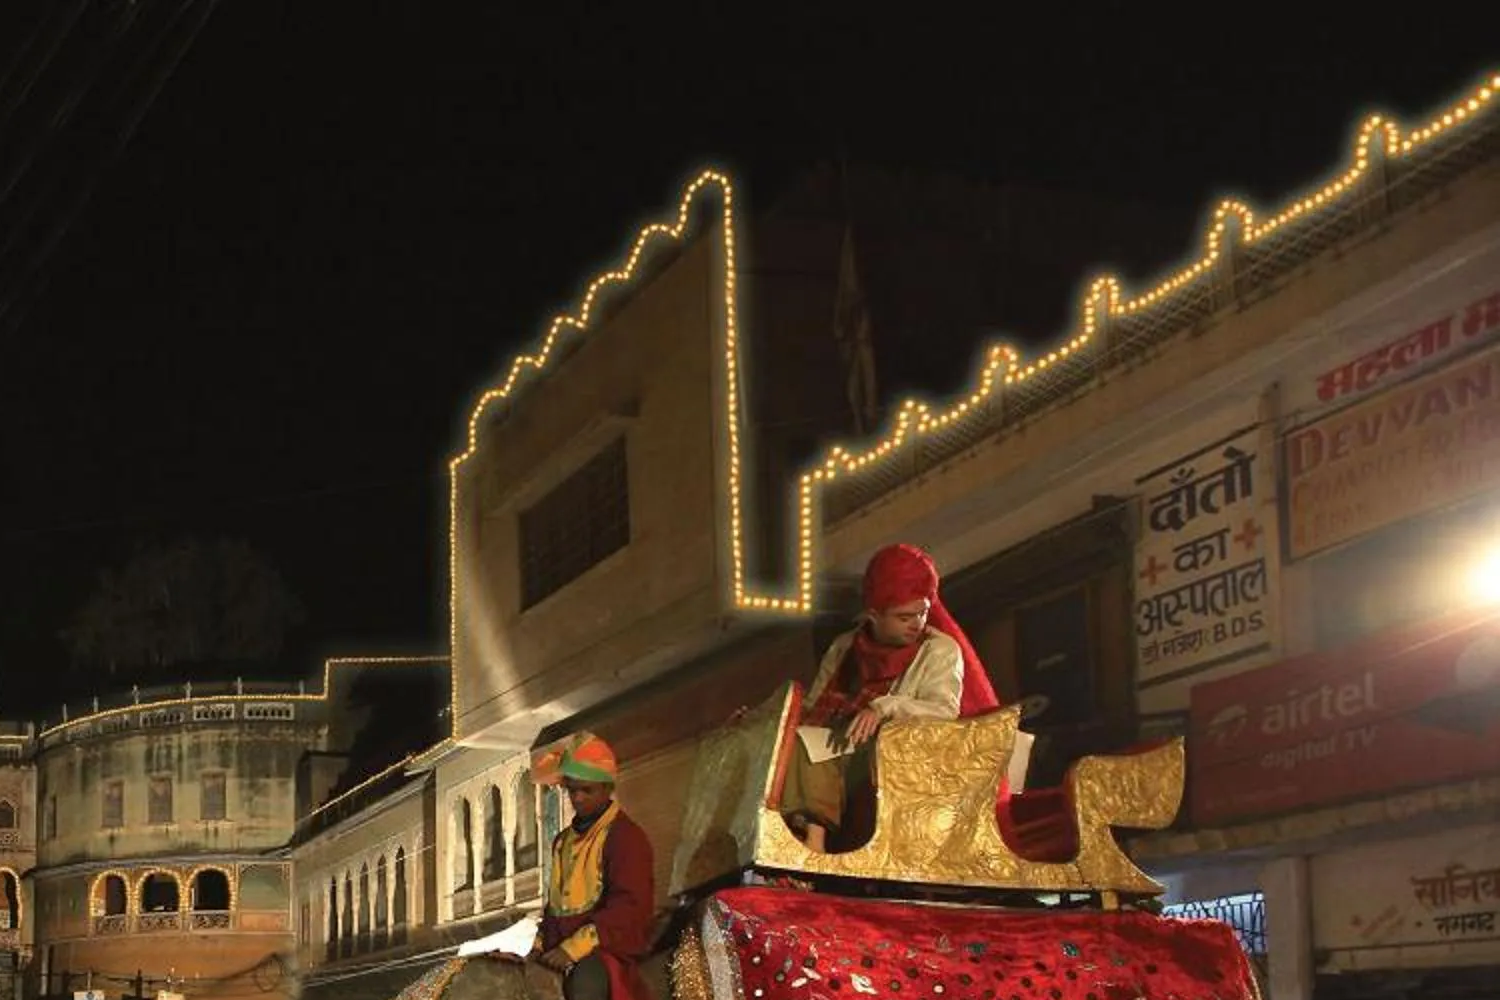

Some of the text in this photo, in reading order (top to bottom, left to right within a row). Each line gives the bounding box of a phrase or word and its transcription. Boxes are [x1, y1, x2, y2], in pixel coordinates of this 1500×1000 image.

[1173, 527, 1231, 572] का
[1137, 557, 1267, 636] अस्पताल
[1262, 672, 1379, 734] airtel
[1260, 724, 1380, 769] digital TV
